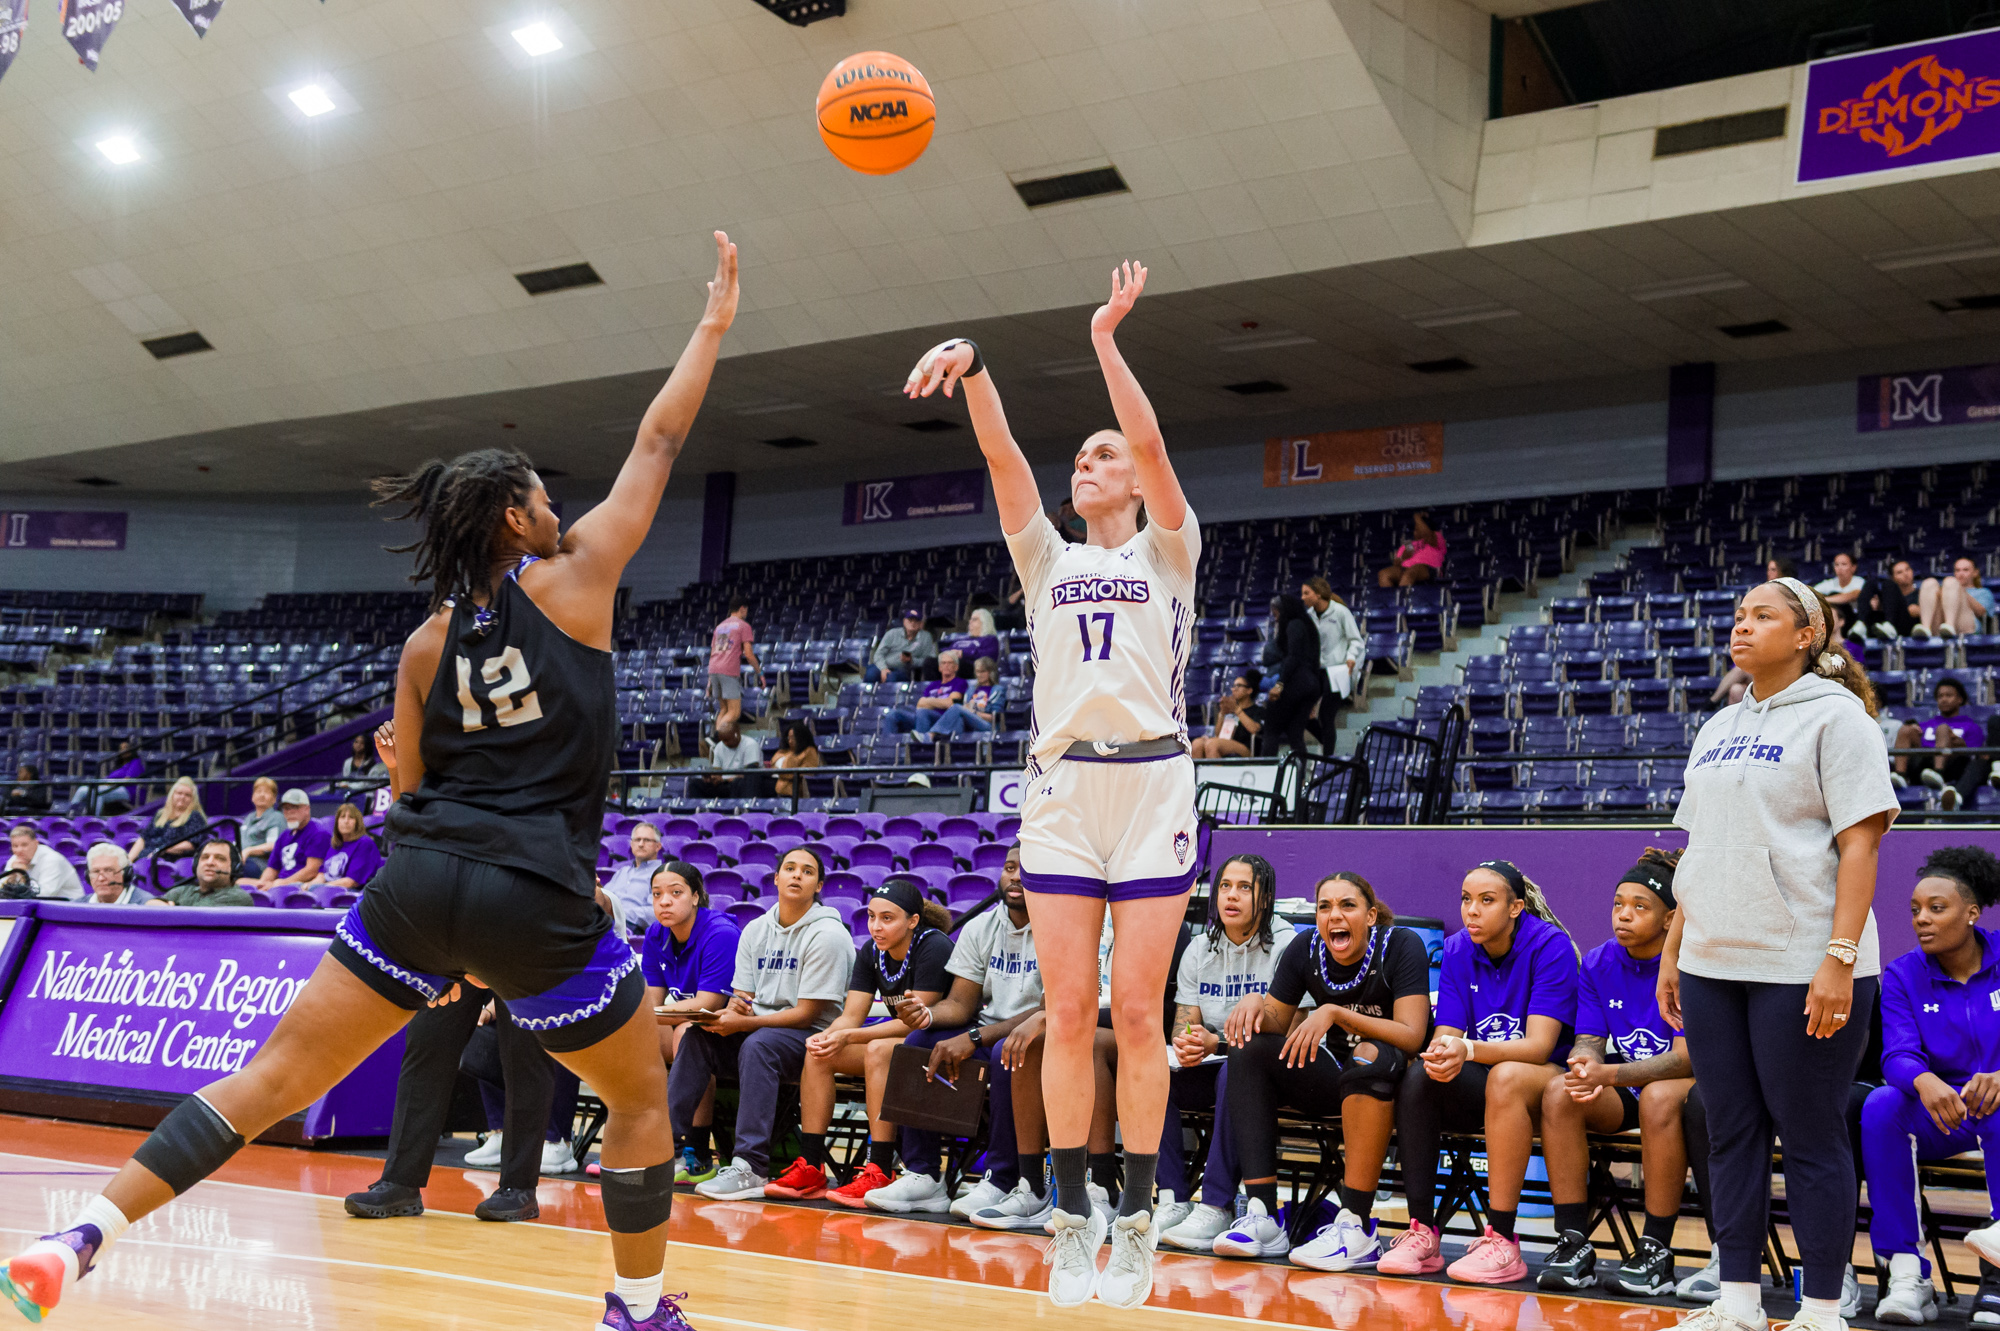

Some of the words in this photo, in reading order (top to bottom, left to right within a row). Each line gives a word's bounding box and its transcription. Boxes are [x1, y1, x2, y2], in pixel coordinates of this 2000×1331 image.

[835, 64, 912, 89] Wilson
[850, 100, 908, 123] NCAA
[1818, 78, 2000, 134] DEMONS
[1892, 374, 1943, 422] M
[1381, 441, 1427, 458] CORE
[1386, 427, 1421, 446] THE
[1291, 440, 1323, 480] L
[864, 481, 894, 519] K
[1051, 579, 1149, 609] DEMONS
[1076, 612, 1115, 662] 17
[456, 645, 543, 732] 12
[374, 788, 391, 812] B
[999, 782, 1019, 808] C
[27, 948, 206, 1009] Natchitoches
[52, 1012, 167, 1065] Medical
[162, 1020, 256, 1073] Center
